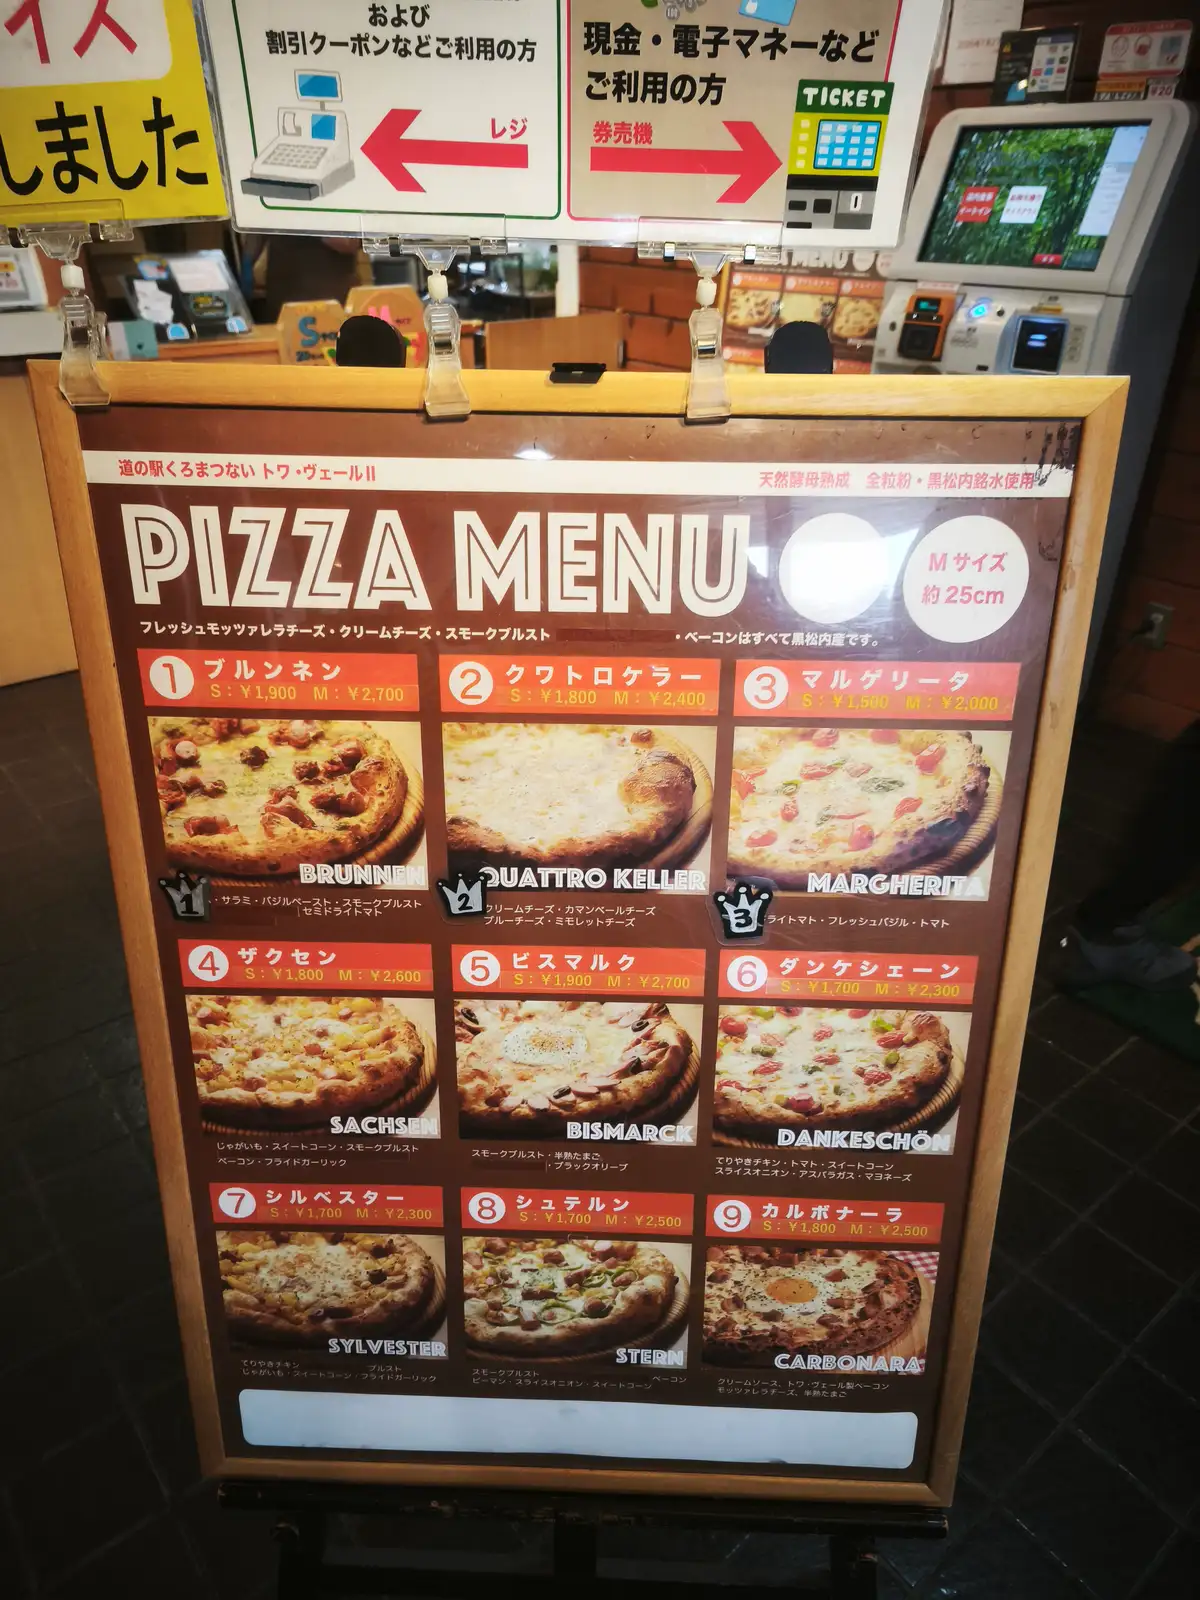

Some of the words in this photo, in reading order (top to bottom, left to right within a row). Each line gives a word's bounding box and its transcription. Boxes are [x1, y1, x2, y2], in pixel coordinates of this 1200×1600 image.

[368, 4, 430, 26] および
[266, 30, 537, 63] 割引クーポンなどご利用の方
[584, 22, 880, 63] 現金・電子マネーなど
[585, 70, 727, 106] ご利用の方
[802, 87, 887, 108] TICKET
[491, 117, 528, 140] レジ
[593, 120, 653, 145] 券売機
[118, 458, 256, 479] 道の駅くろまつない
[758, 471, 850, 490] 天然酵母熟成
[120, 503, 432, 611] PIZZA
[453, 510, 750, 617] MENU
[928, 552, 948, 572] M
[953, 552, 1007, 574] サイズ
[921, 586, 941, 605] 約
[945, 586, 1005, 606] 25cm
[162, 663, 177, 694] 1
[203, 657, 342, 681] ブルンネン
[460, 668, 483, 700] 2
[505, 664, 702, 687] クワトロケラー
[754, 672, 777, 705] 3
[802, 668, 969, 692] マルゲリータ
[299, 863, 425, 887] BRUNNEN
[613, 868, 707, 891] KELLER
[807, 872, 985, 898] MARGHERITA
[198, 951, 220, 977] 4
[238, 947, 337, 966] ザクセン
[470, 956, 490, 982] 5
[512, 953, 636, 971] ビスマルク
[737, 960, 757, 988] 6
[779, 957, 960, 980] ダンケシェーン
[330, 1115, 438, 1135] SACHSEN
[566, 1121, 695, 1143] BISMARCK
[777, 1128, 951, 1152] DANKESCHÖN
[227, 1192, 245, 1214] 7
[265, 1189, 404, 1206] シルベスター
[478, 1197, 497, 1220] 8
[516, 1194, 630, 1212] シュテルン
[723, 1204, 742, 1228] 9
[762, 1203, 903, 1223] カルボナーラ
[328, 1338, 447, 1357] SYLVESTER
[615, 1347, 684, 1366] STERN
[774, 1353, 922, 1373] CARBONARA
